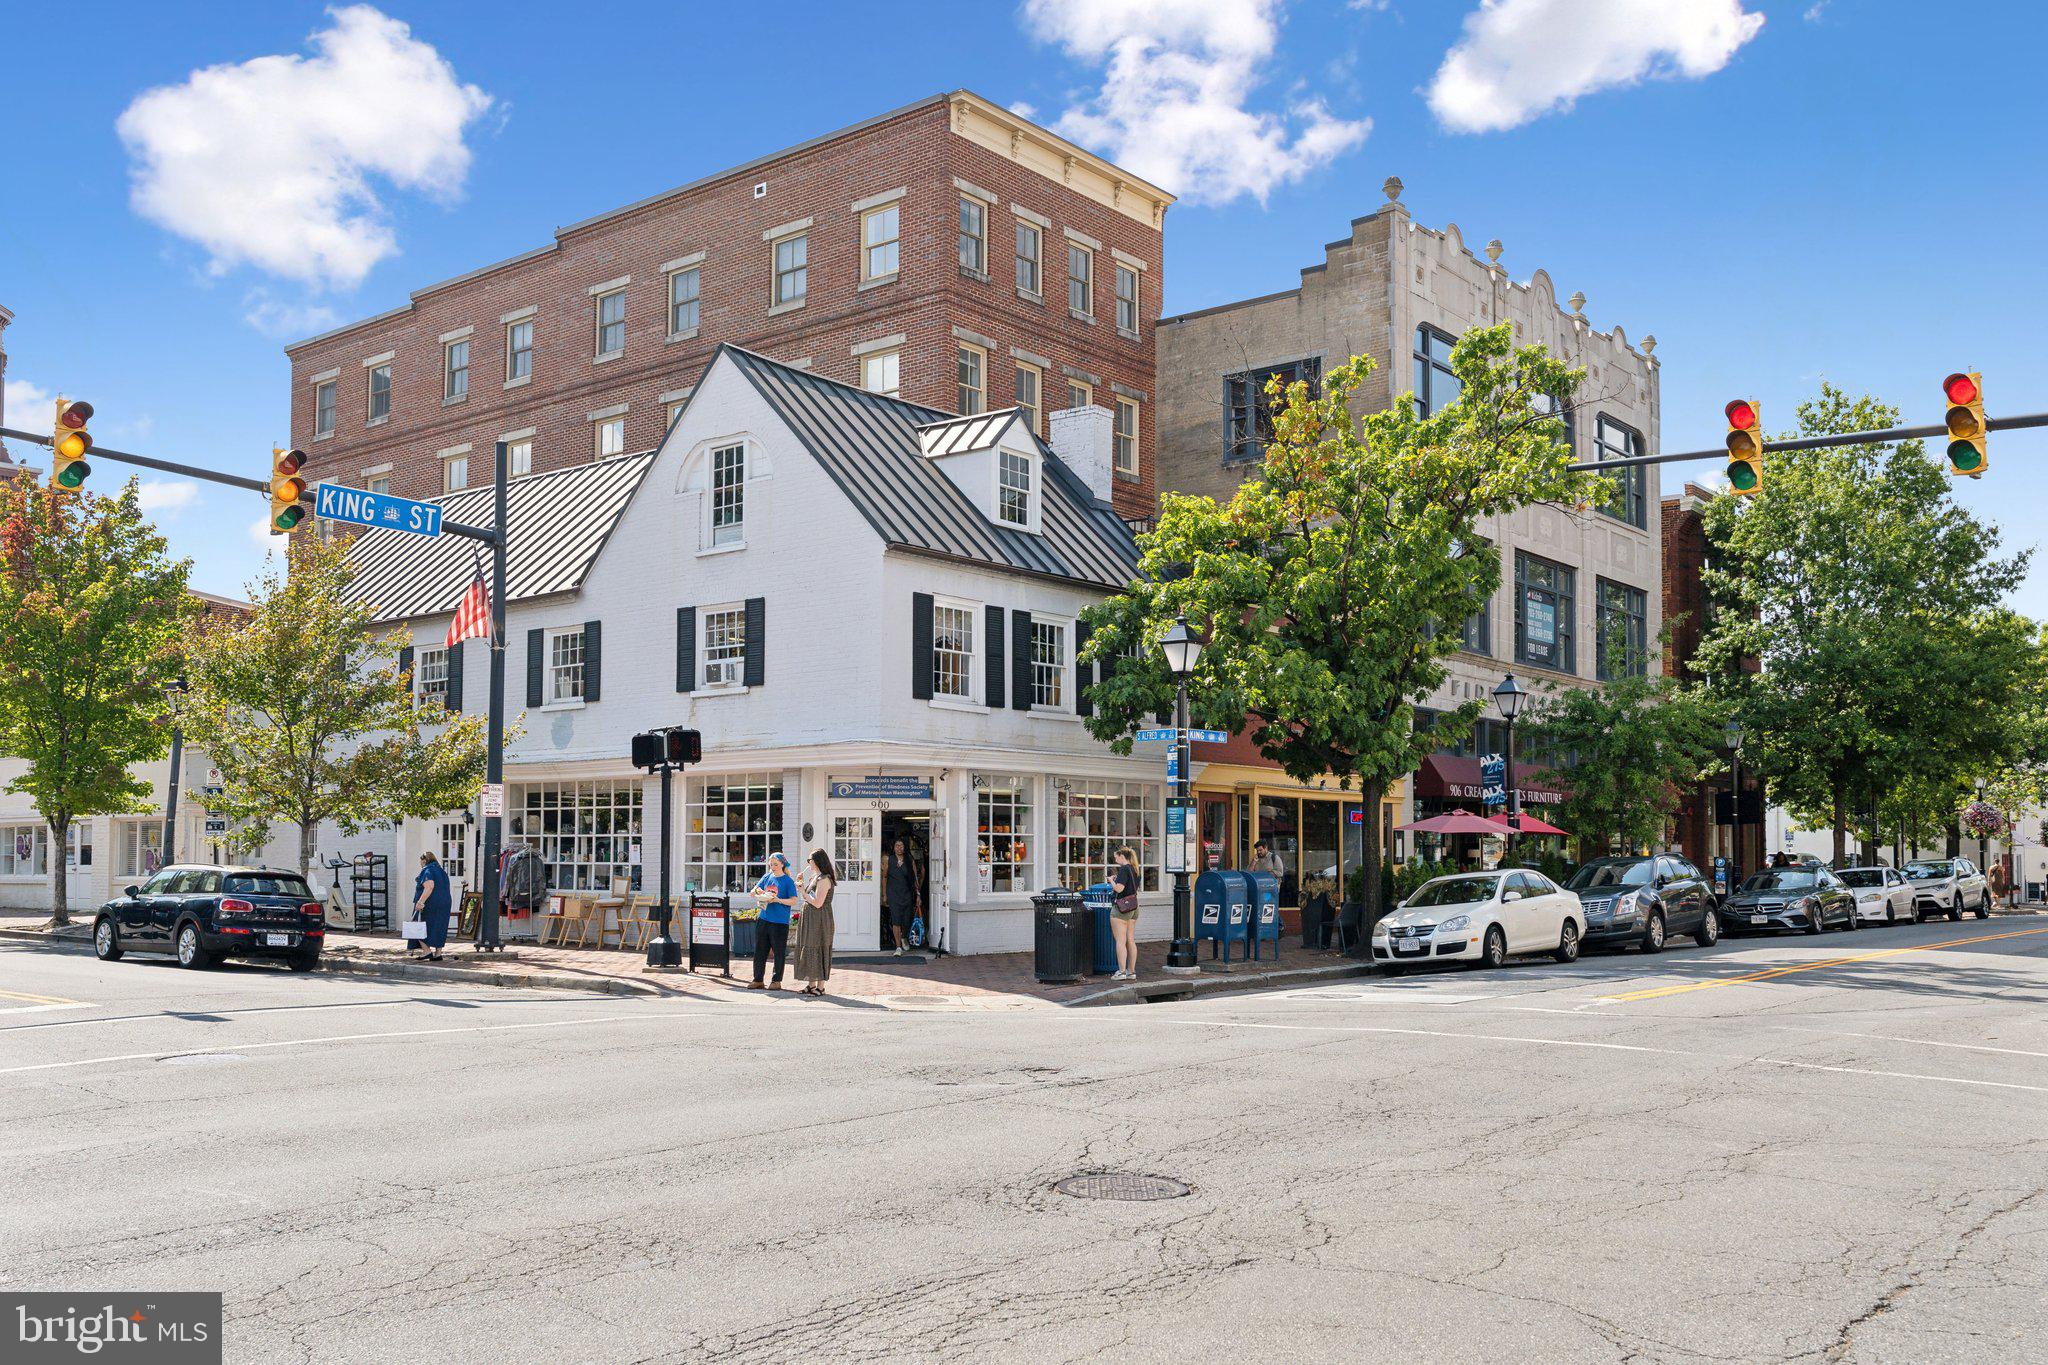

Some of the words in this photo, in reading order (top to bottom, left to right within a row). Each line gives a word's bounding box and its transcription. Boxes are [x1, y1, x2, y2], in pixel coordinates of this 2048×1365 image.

[321, 488, 376, 521] KING
[409, 505, 437, 532] ST
[1528, 642, 1536, 654] FOR
[1536, 644, 1548, 656] LEASE
[1137, 731, 1141, 740] S
[1141, 731, 1158, 740] ALFRED
[1190, 731, 1205, 740] KING
[1480, 753, 1504, 768] ALX
[1487, 761, 1505, 774] 275
[1450, 785, 1461, 797] 906
[1464, 786, 1484, 798] CREA
[1527, 791, 1562, 804] FURNITURE
[1482, 784, 1505, 800] ALX
[871, 801, 890, 809] 900
[1488, 793, 1507, 805] 275
